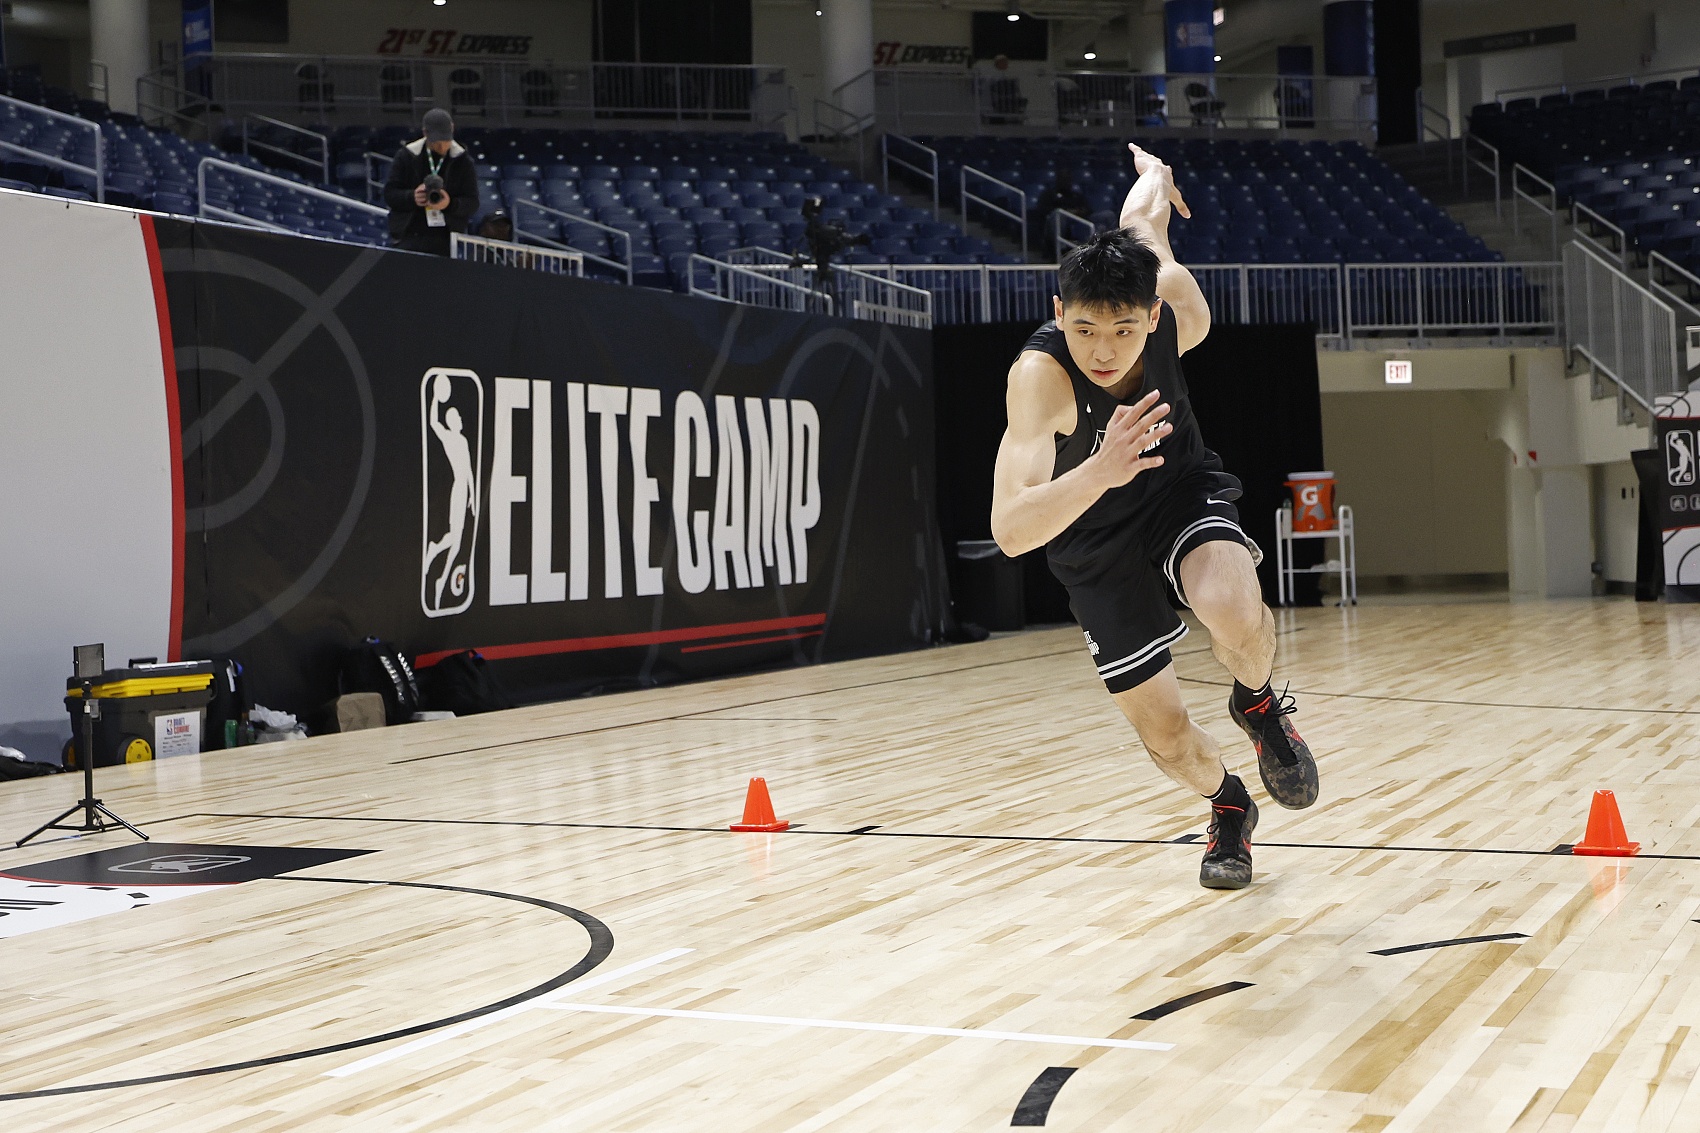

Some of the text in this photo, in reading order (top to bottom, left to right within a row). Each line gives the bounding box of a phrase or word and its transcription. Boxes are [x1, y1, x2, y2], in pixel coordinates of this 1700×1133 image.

[457, 34, 532, 54] EXPRESS
[901, 45, 970, 64] EXPRESS
[1389, 364, 1407, 380] EXIT
[489, 377, 821, 607] ELITE CAMP
[1301, 485, 1318, 506] G
[450, 564, 467, 597] G
